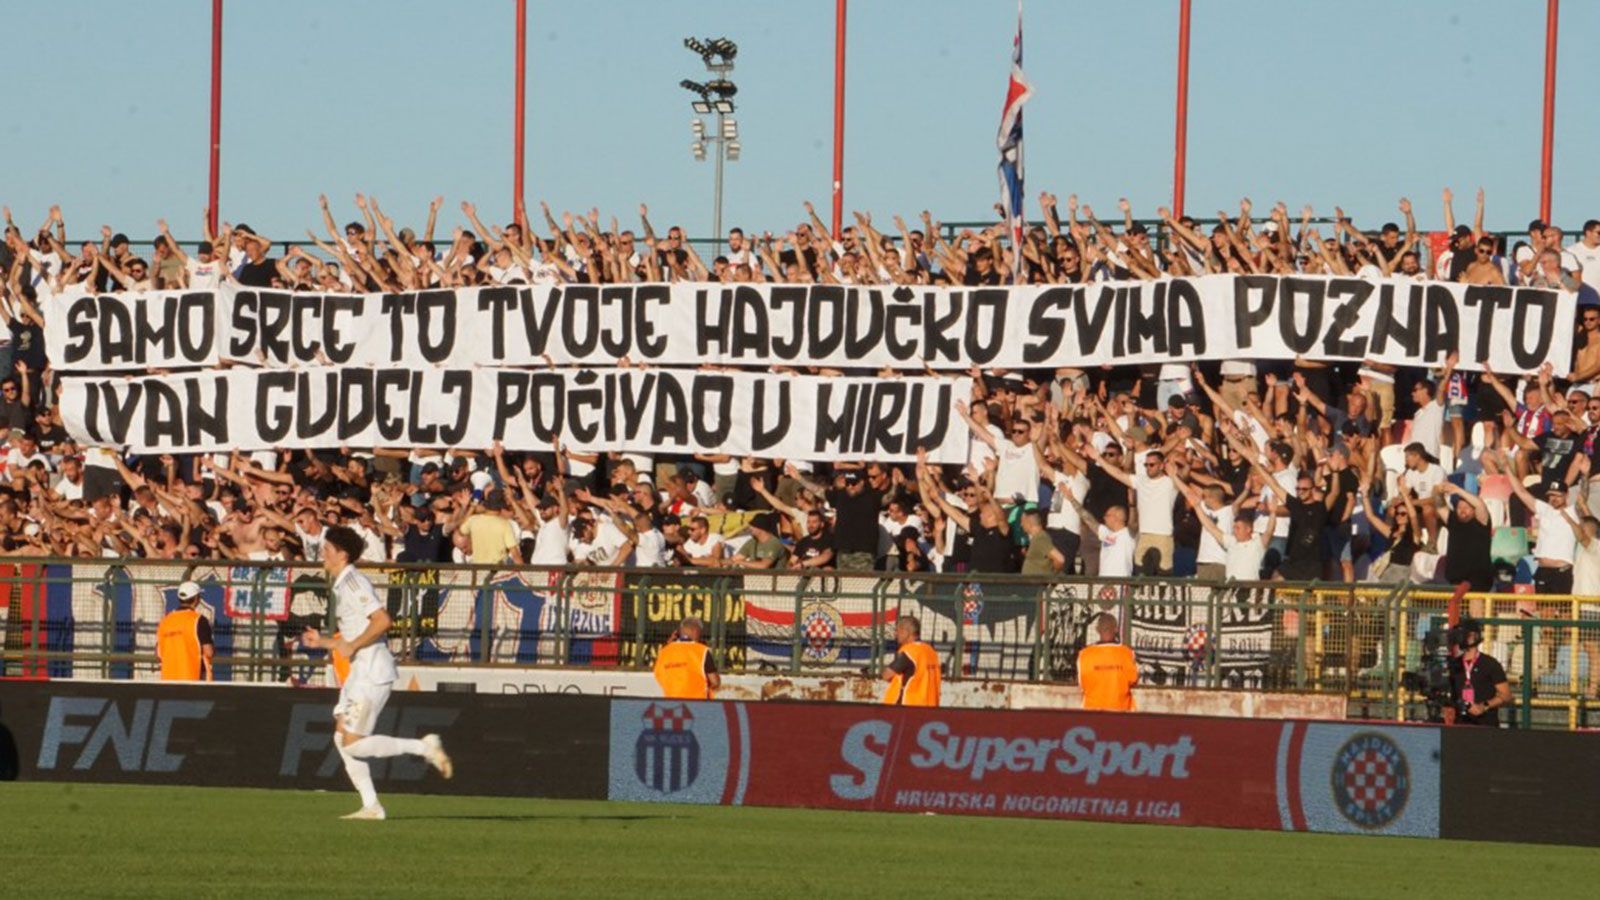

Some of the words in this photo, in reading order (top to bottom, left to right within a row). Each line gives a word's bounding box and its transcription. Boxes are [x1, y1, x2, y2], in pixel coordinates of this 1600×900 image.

[65, 293, 215, 364] SAMO
[230, 291, 364, 364] SRCE
[382, 289, 456, 362] TO
[479, 285, 670, 360] TVOJE
[697, 286, 1008, 364] HAJDUČKO
[1024, 279, 1207, 364] SVIMA
[1235, 275, 1557, 370] POZNATO
[85, 374, 228, 447] IVAN
[256, 367, 472, 445] GUDELJ
[493, 368, 733, 449] POČIVAO
[752, 379, 791, 451] U
[815, 382, 951, 455] MIRU
[37, 696, 212, 771] FNC
[911, 722, 1194, 783] SuperSport
[895, 790, 996, 809] HRVATSKA
[1002, 795, 1129, 815] NOGOMETNA
[1135, 801, 1181, 818] LIGA
